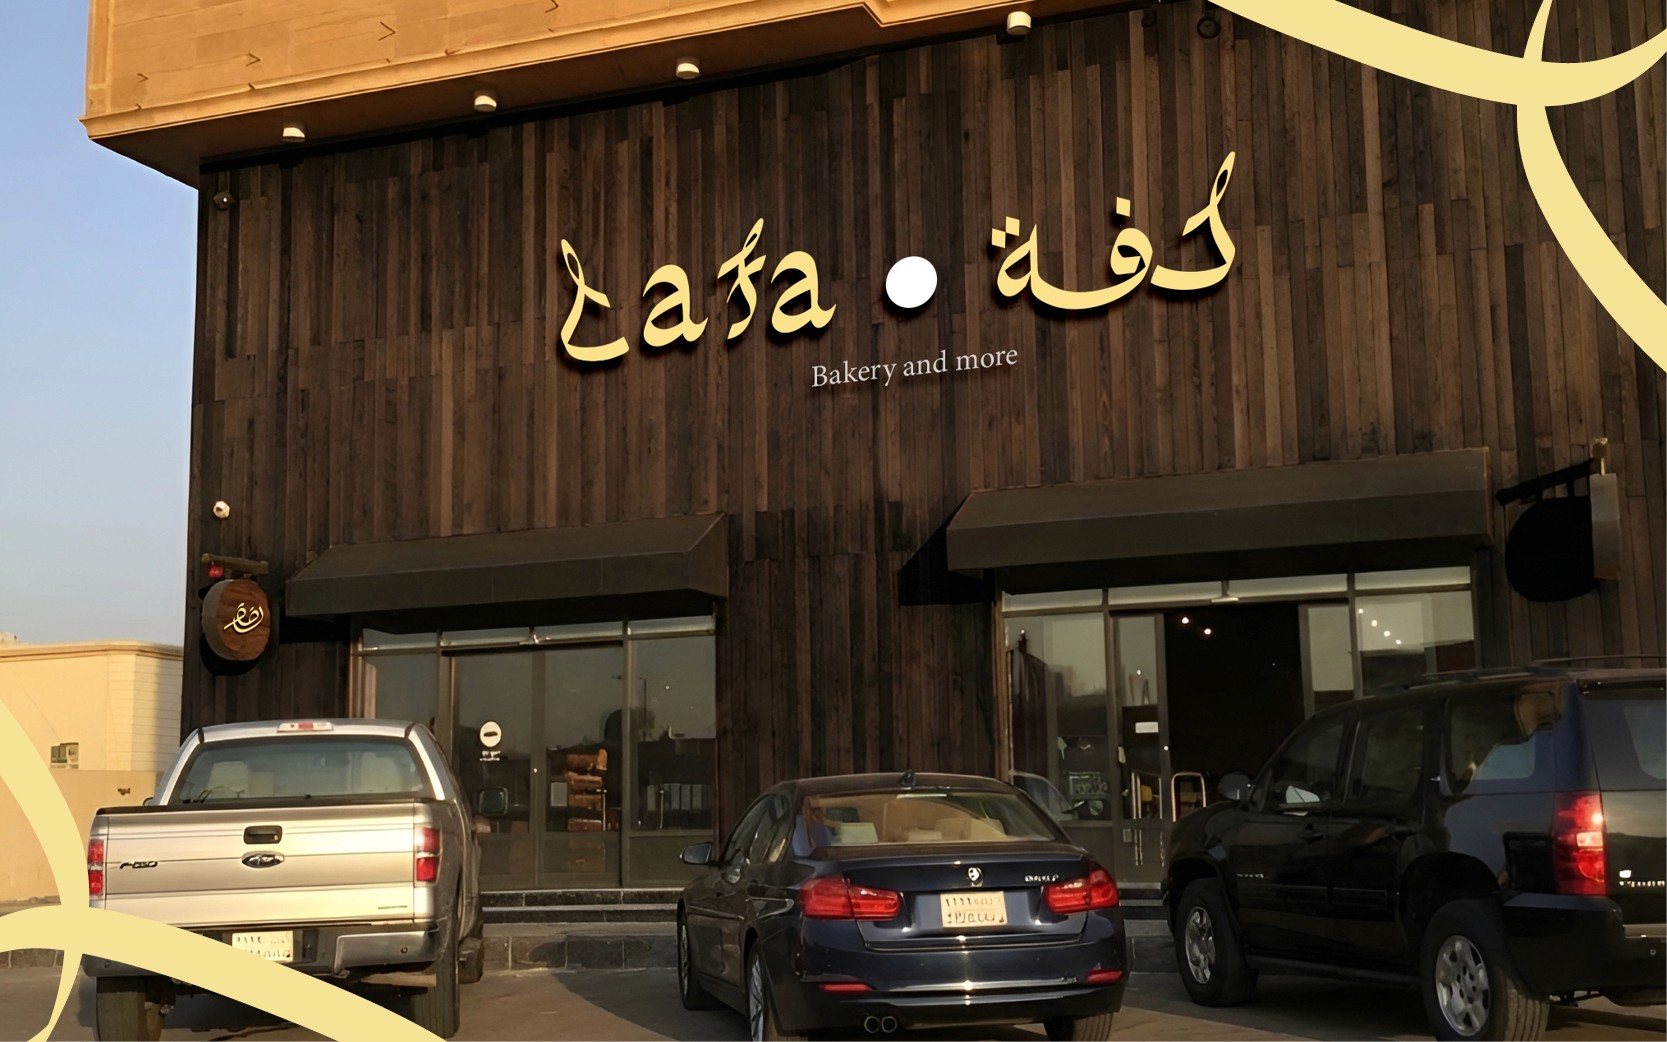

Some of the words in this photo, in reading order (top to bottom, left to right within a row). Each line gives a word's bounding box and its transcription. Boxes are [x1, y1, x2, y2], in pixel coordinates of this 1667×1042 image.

[811, 361, 898, 389] Bakery
[902, 352, 948, 379] and
[954, 346, 1019, 371] more
